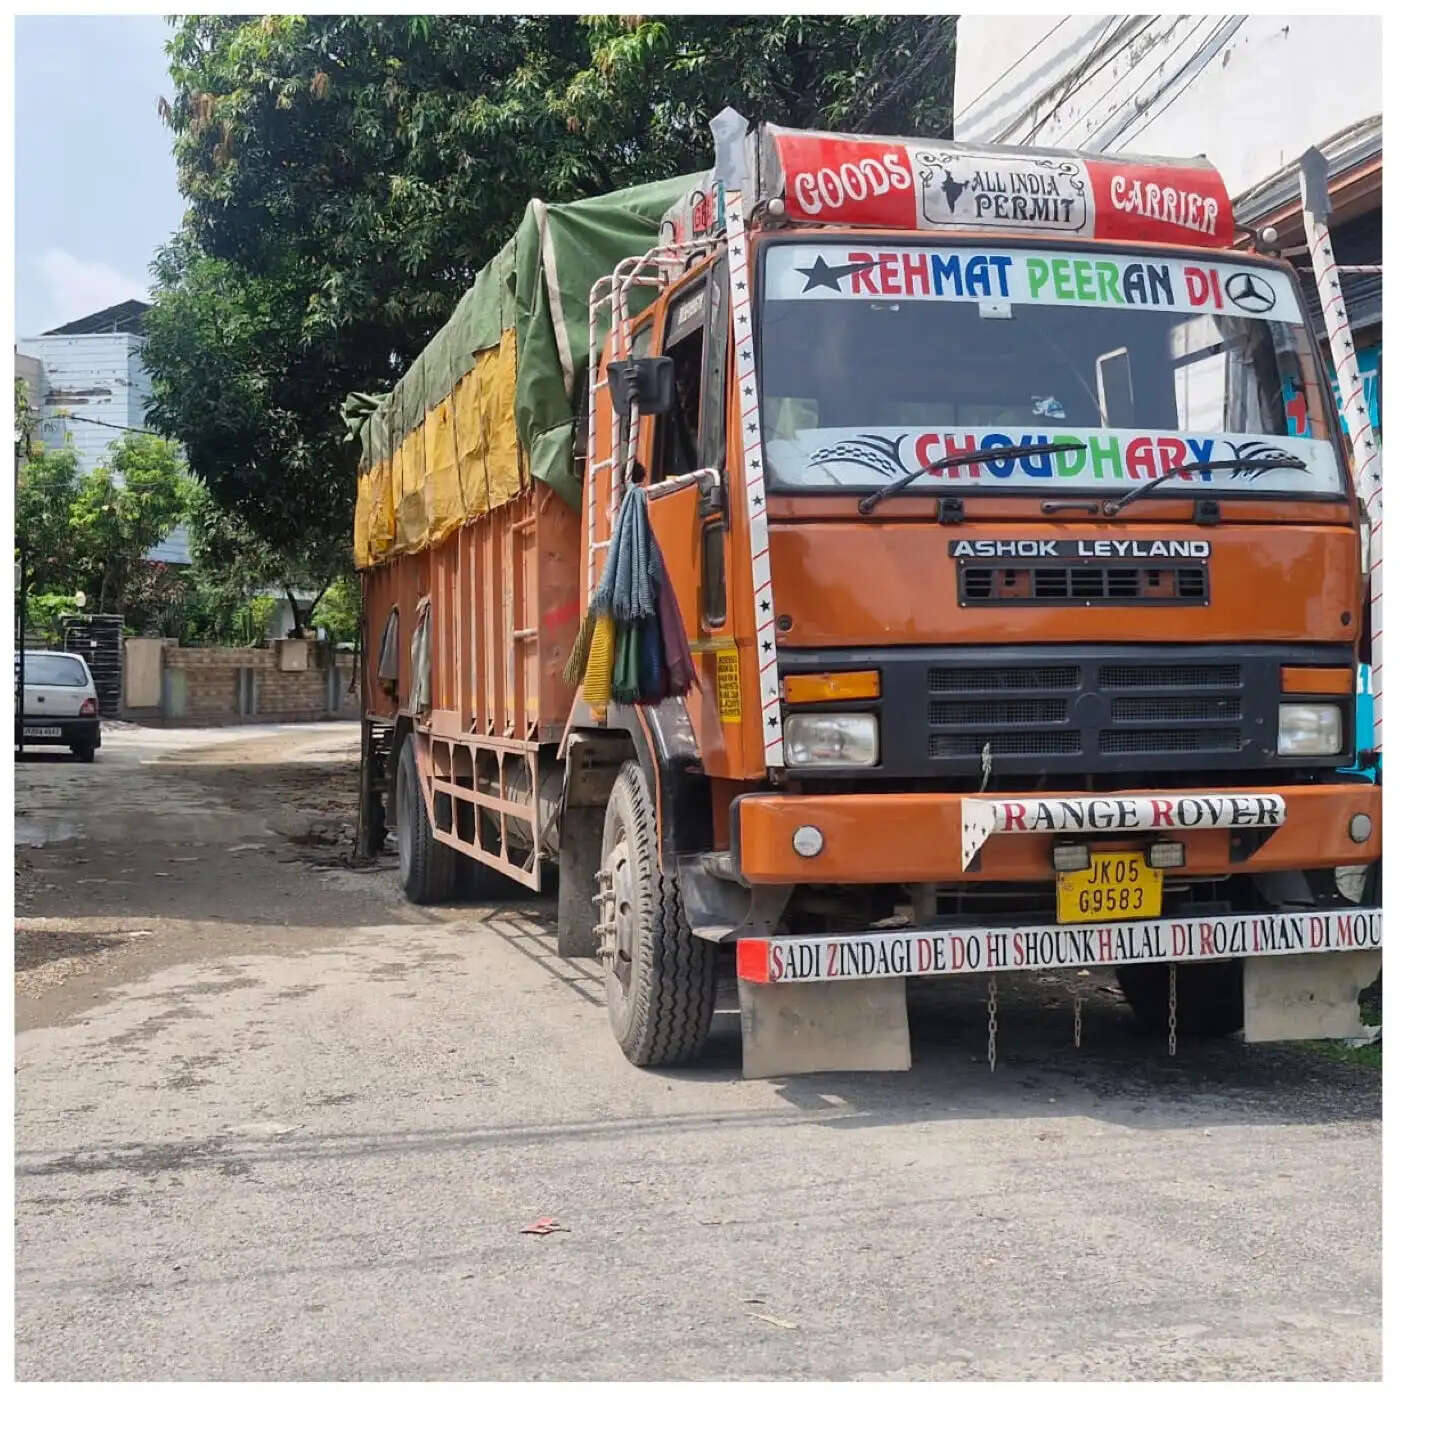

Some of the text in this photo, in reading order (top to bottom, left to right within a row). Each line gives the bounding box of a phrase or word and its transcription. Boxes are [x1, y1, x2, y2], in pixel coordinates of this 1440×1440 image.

[794, 152, 913, 216] GOODS
[971, 170, 1060, 198] ALL INDIA
[974, 194, 1075, 223] PERMIT
[1110, 175, 1220, 236] CARRIER
[847, 251, 1225, 309] REHMAT PEERAN DI
[913, 432, 1215, 483] CHOUDHARY
[953, 540, 1210, 558] ASHOK LEYLAND
[1003, 796, 1285, 832] RANGE ROVER
[1088, 861, 1140, 884] JK05
[1078, 887, 1144, 914] G9583
[771, 942, 821, 980] SADI
[827, 938, 912, 977] ZINDAGI
[917, 937, 946, 972] DE
[951, 935, 980, 971] DO
[987, 933, 1008, 968] HI
[1172, 923, 1194, 957] DI
[1252, 916, 1304, 951] IMAN
[1310, 916, 1331, 948] DI
